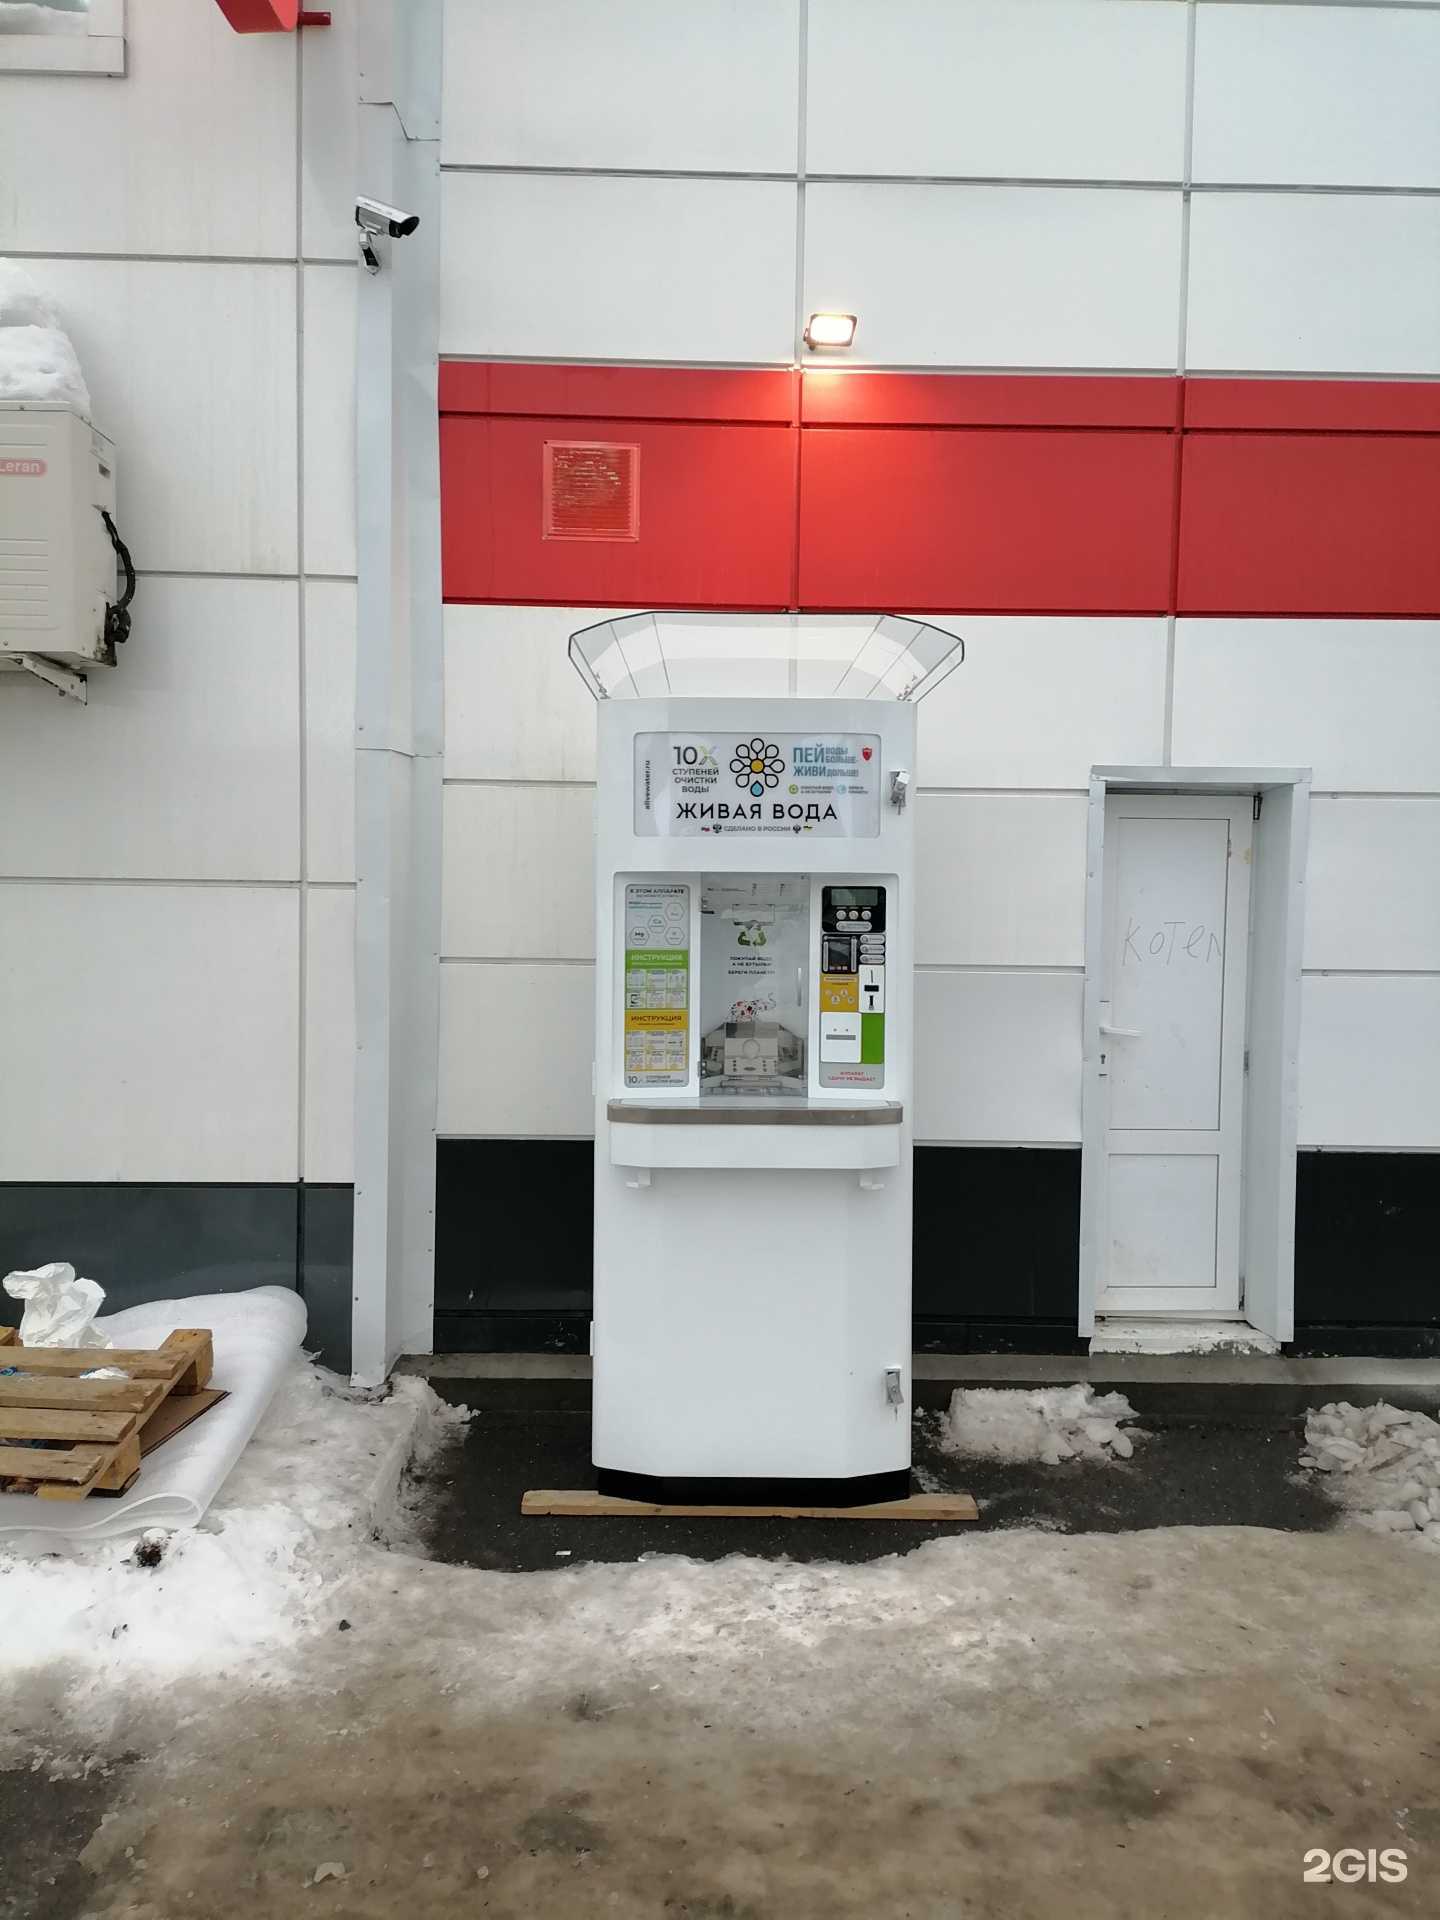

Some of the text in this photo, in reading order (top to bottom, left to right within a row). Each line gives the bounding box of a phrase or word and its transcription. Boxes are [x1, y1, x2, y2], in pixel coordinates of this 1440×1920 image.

[793, 743, 848, 763] ПЕЙ ВОДЫ
[671, 766, 720, 776] СТУПЕНЕЙ
[793, 766, 826, 777] ЖИВИ
[674, 776, 718, 784] ОЧИСТКИ
[681, 785, 710, 793] ВОДЫ
[676, 802, 838, 822] ЖИВАЯ ВОДА
[723, 825, 756, 833] СДЕЛАНО
